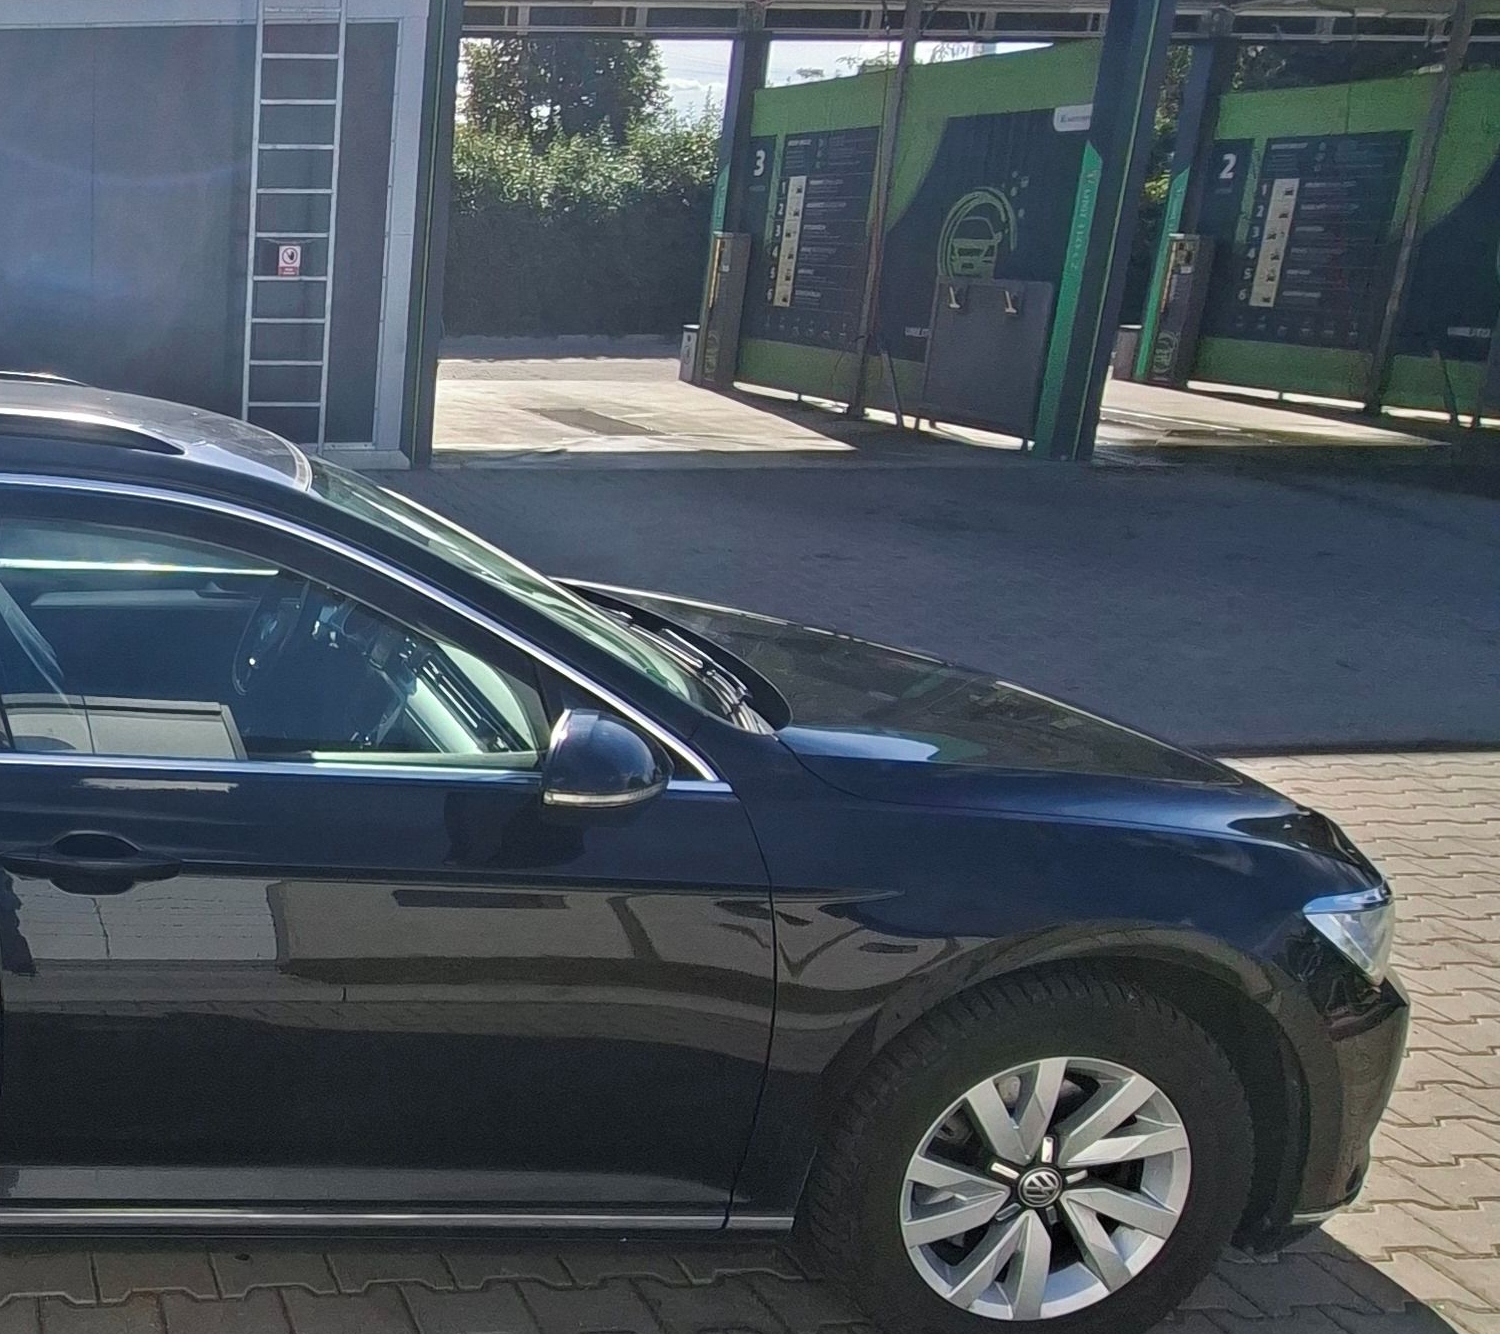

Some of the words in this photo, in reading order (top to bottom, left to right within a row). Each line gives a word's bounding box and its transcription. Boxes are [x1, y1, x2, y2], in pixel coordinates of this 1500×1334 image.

[753, 149, 766, 176] 3
[1219, 153, 1237, 179] 2
[1261, 184, 1267, 195] 1
